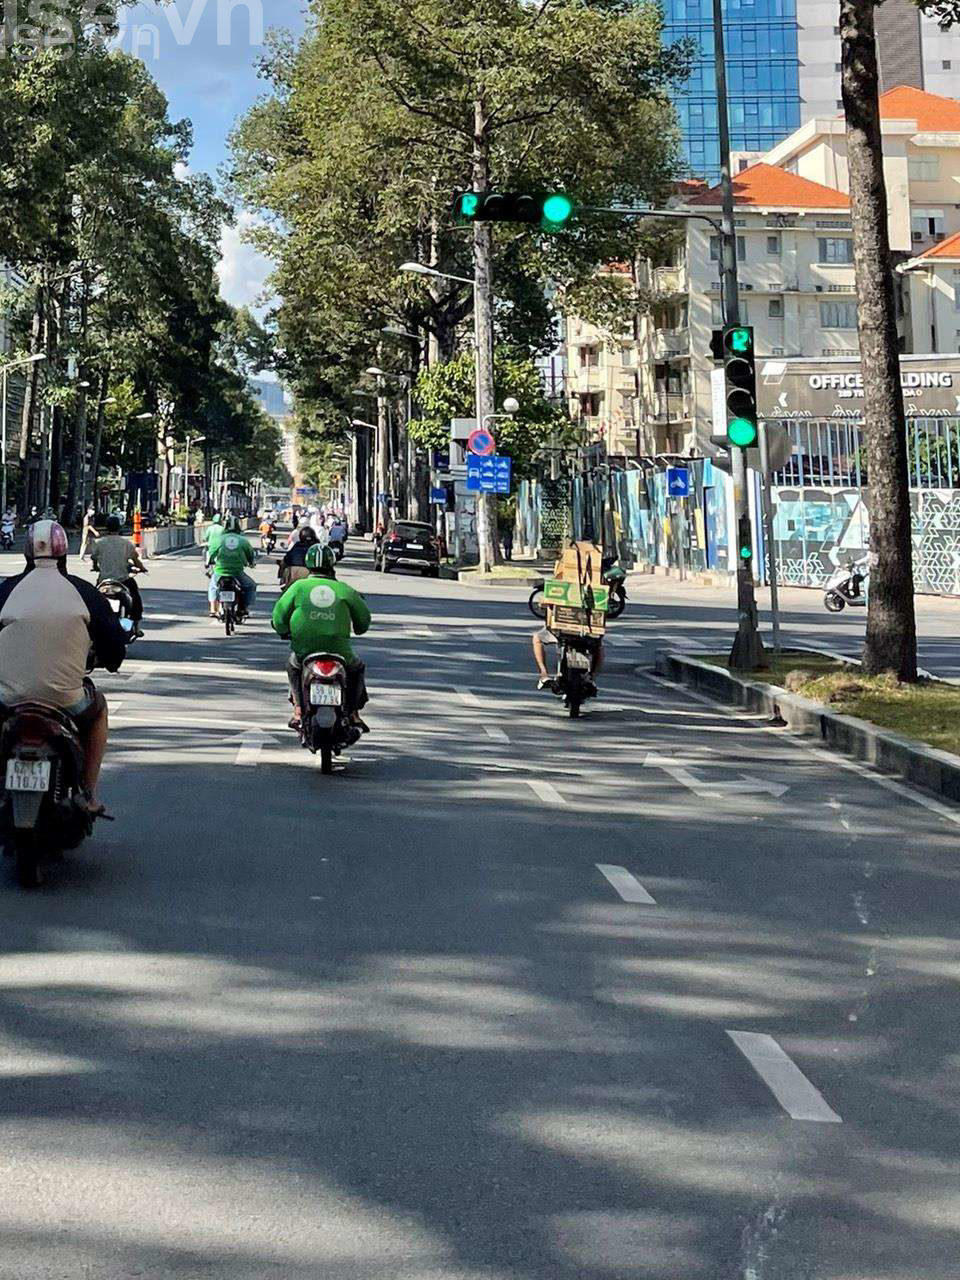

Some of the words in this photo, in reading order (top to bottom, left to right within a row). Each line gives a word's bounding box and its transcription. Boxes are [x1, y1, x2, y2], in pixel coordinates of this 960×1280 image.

[809, 373, 865, 390] OFFICE
[900, 372, 953, 388] LDING
[309, 609, 336, 621] Grab
